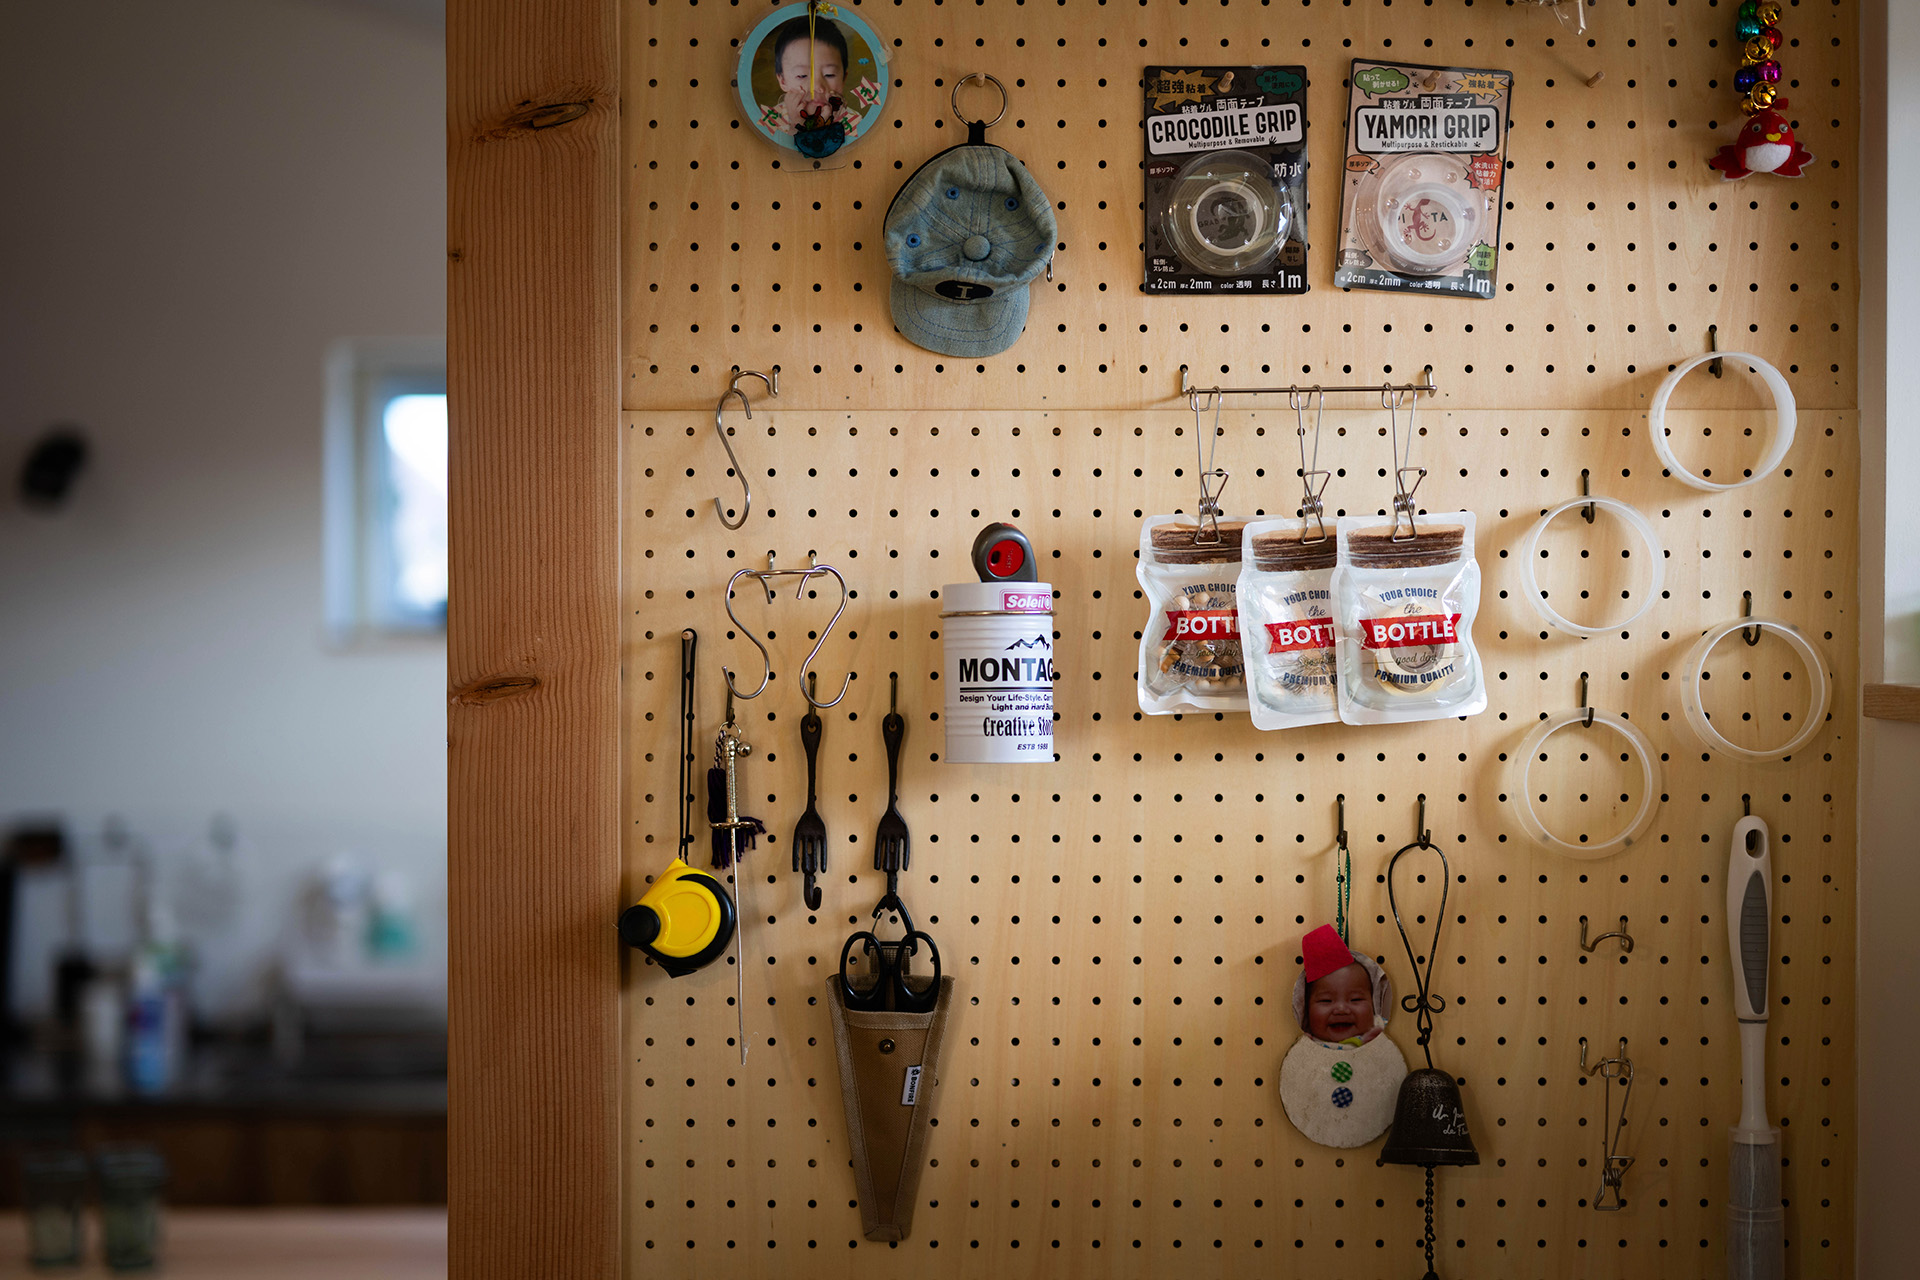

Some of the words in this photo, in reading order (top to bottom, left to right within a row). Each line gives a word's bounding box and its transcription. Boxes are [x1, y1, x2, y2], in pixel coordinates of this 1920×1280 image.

[1156, 79, 1207, 94] 超強粘着
[1468, 80, 1496, 89] 強粘着
[1152, 113, 1250, 143] CROCODILE
[1255, 109, 1297, 134] GRIP
[1364, 114, 1438, 139] YAMORI
[1444, 114, 1491, 139] GRIP
[1188, 139, 1227, 149] Multipurpose
[1234, 136, 1265, 145] Removable
[1381, 140, 1423, 149] Multipurpose
[1424, 140, 1429, 148] &
[1430, 140, 1468, 149] Restickable
[1274, 162, 1302, 178] 防水
[1157, 278, 1177, 289] 2cm
[1190, 278, 1212, 289] 2mm
[1236, 280, 1252, 289] 透明
[1277, 270, 1302, 289] 1m
[1347, 271, 1366, 283] 2cm
[1379, 274, 1401, 287] 2mm
[1424, 280, 1441, 290] 透明
[1467, 273, 1490, 293] 1m
[1182, 584, 1206, 596] YOUR
[1283, 590, 1307, 605] YOUR
[1308, 590, 1331, 600] CHOI
[1379, 589, 1403, 603] YOUR
[1405, 587, 1438, 599] CHOICE
[1006, 595, 1045, 610] Soleil
[1206, 599, 1226, 611] the
[1403, 603, 1422, 615] the
[1307, 605, 1327, 617] the
[1374, 620, 1454, 643] BOTTLE
[1395, 653, 1418, 666] good
[1173, 660, 1217, 677] PREMIUM
[1374, 669, 1418, 684] PREMIUM
[1420, 663, 1455, 683] QUALITY
[1283, 672, 1327, 686] PREMIUM
[959, 694, 985, 703] Design
[986, 694, 1006, 702] Your
[991, 703, 1013, 712] Light
[983, 716, 1035, 736] Creative
